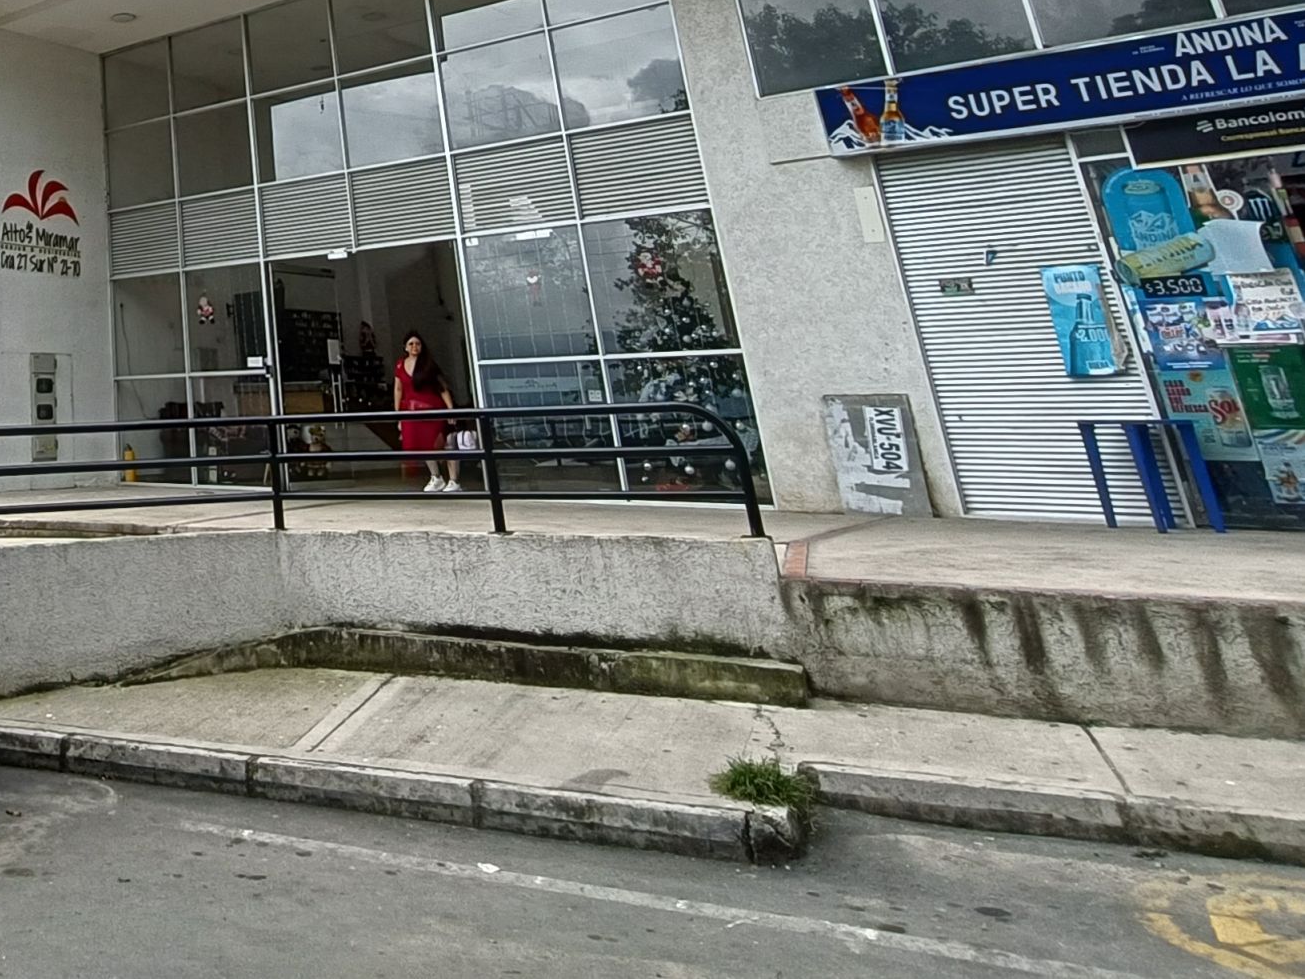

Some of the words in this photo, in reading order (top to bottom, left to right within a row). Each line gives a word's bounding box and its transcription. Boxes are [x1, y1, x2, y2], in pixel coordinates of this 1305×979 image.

[1175, 17, 1288, 57] ANDINA
[947, 83, 1060, 120] SUPER
[1071, 60, 1215, 103] TIENDA
[1225, 50, 1282, 81] LA
[1189, 87, 1239, 100] REFRESCAR
[1215, 109, 1305, 129] Bancolom
[2, 222, 33, 244] Altos
[36, 227, 80, 252] Miramar
[0, 251, 15, 270] Cra
[16, 253, 27, 270] 27
[29, 254, 45, 273] Sur
[1054, 271, 1085, 283] PUNTO
